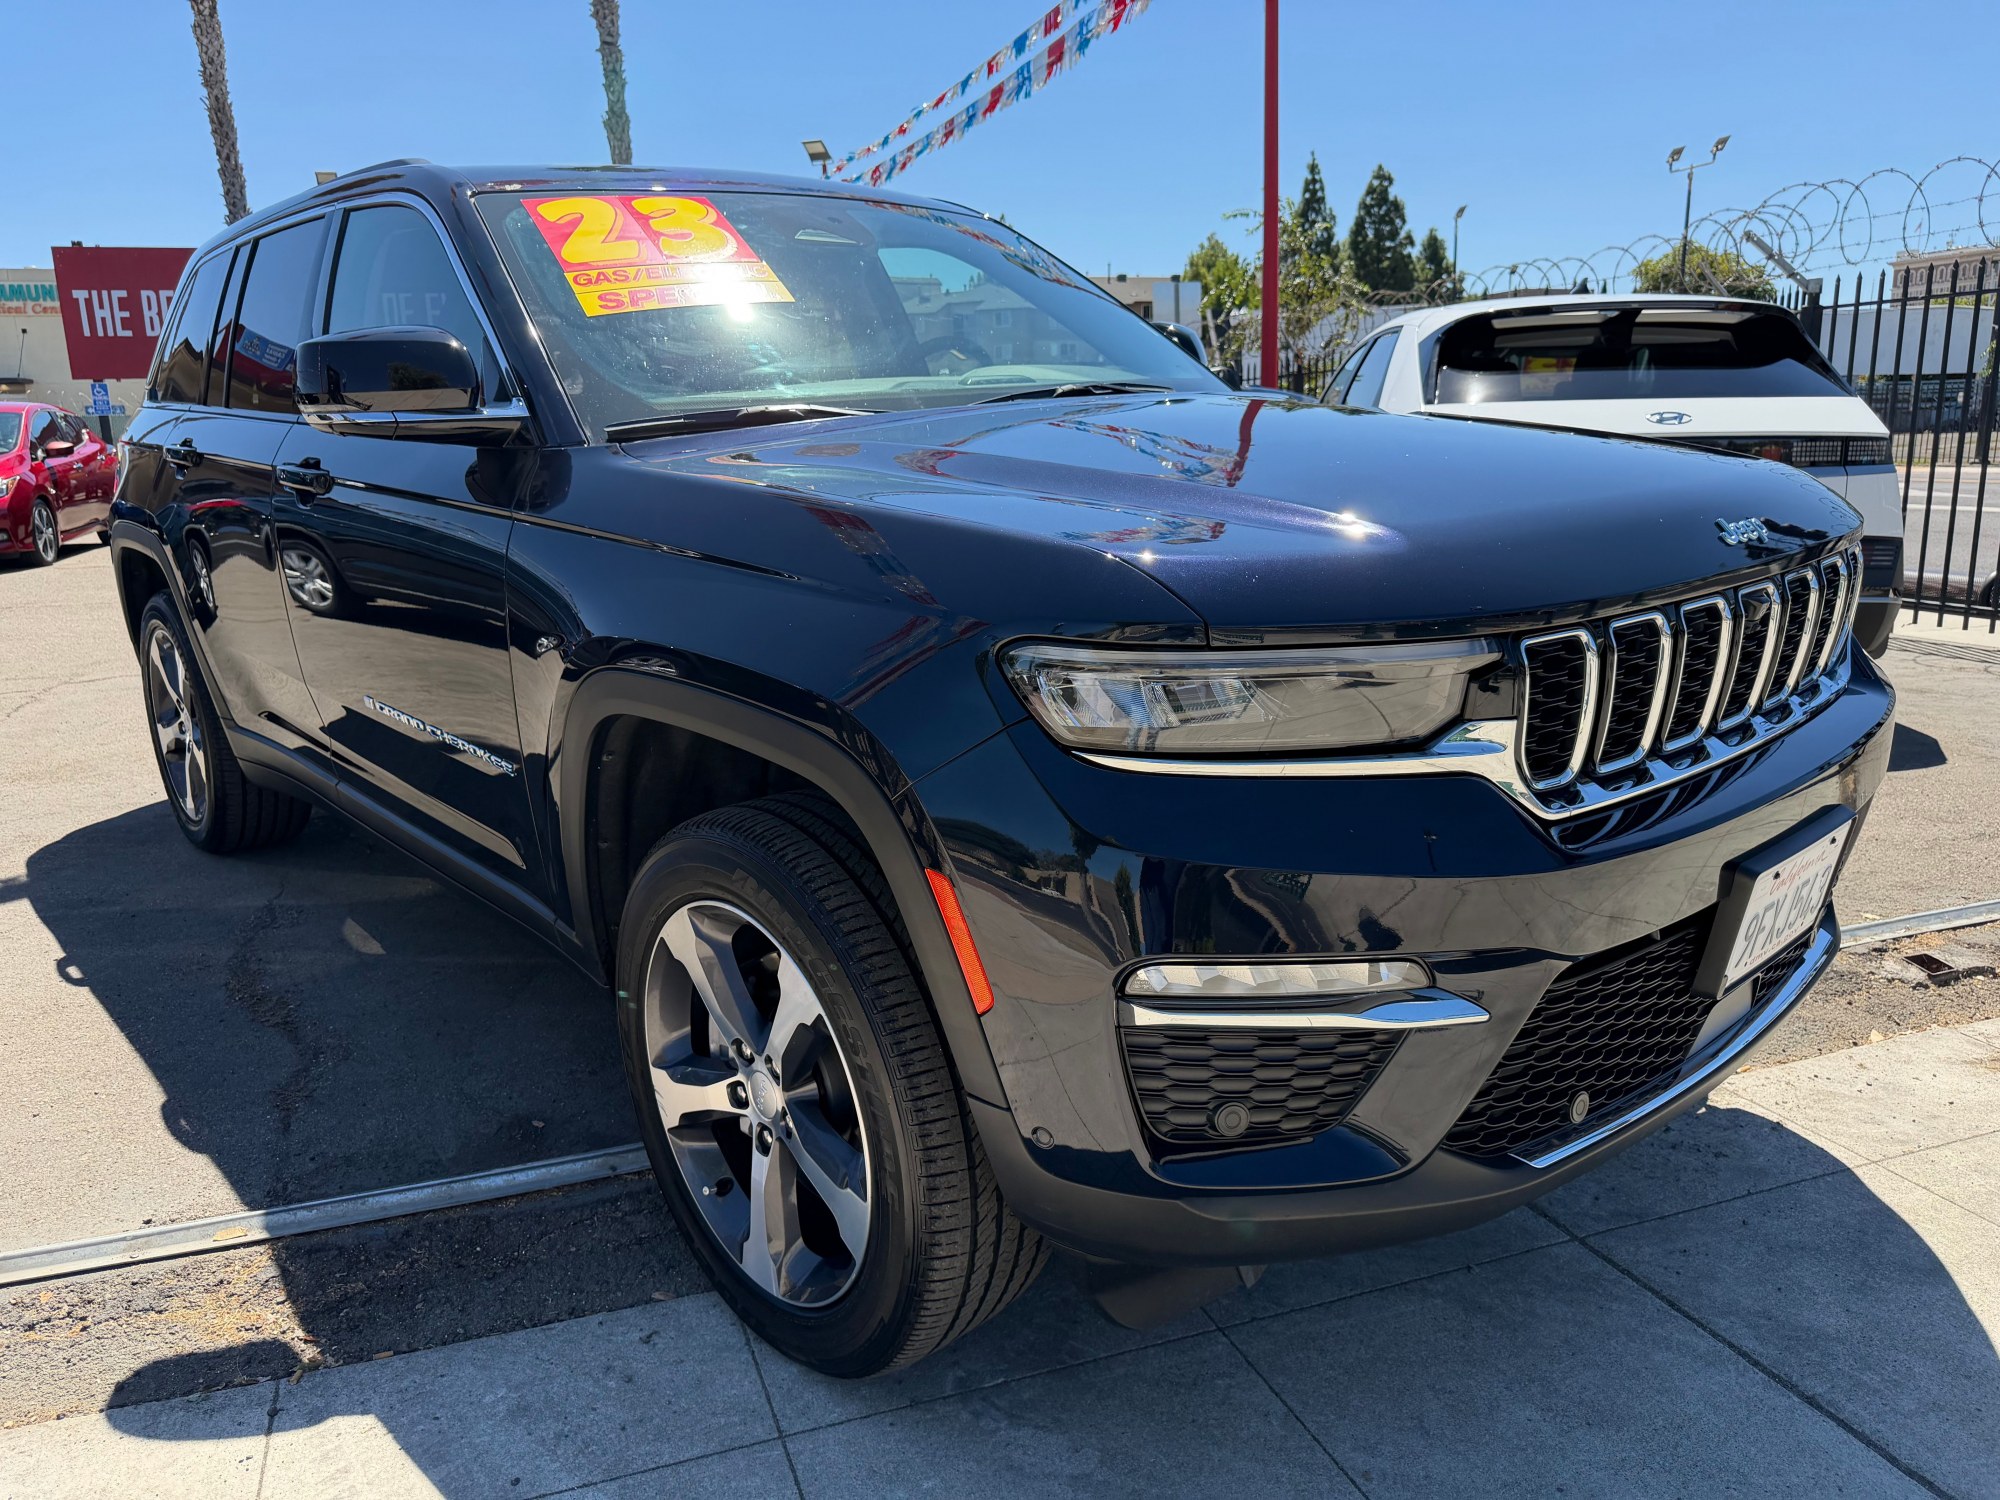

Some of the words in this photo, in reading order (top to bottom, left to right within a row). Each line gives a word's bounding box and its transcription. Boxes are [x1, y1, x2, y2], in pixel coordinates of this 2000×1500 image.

[537, 196, 738, 265] 23
[0, 284, 58, 302] MUN
[0, 303, 28, 314] ical
[72, 290, 133, 337] THE
[1715, 518, 1768, 545] Jeep
[376, 701, 426, 731] GRAND
[426, 725, 515, 777] CHEROKEE
